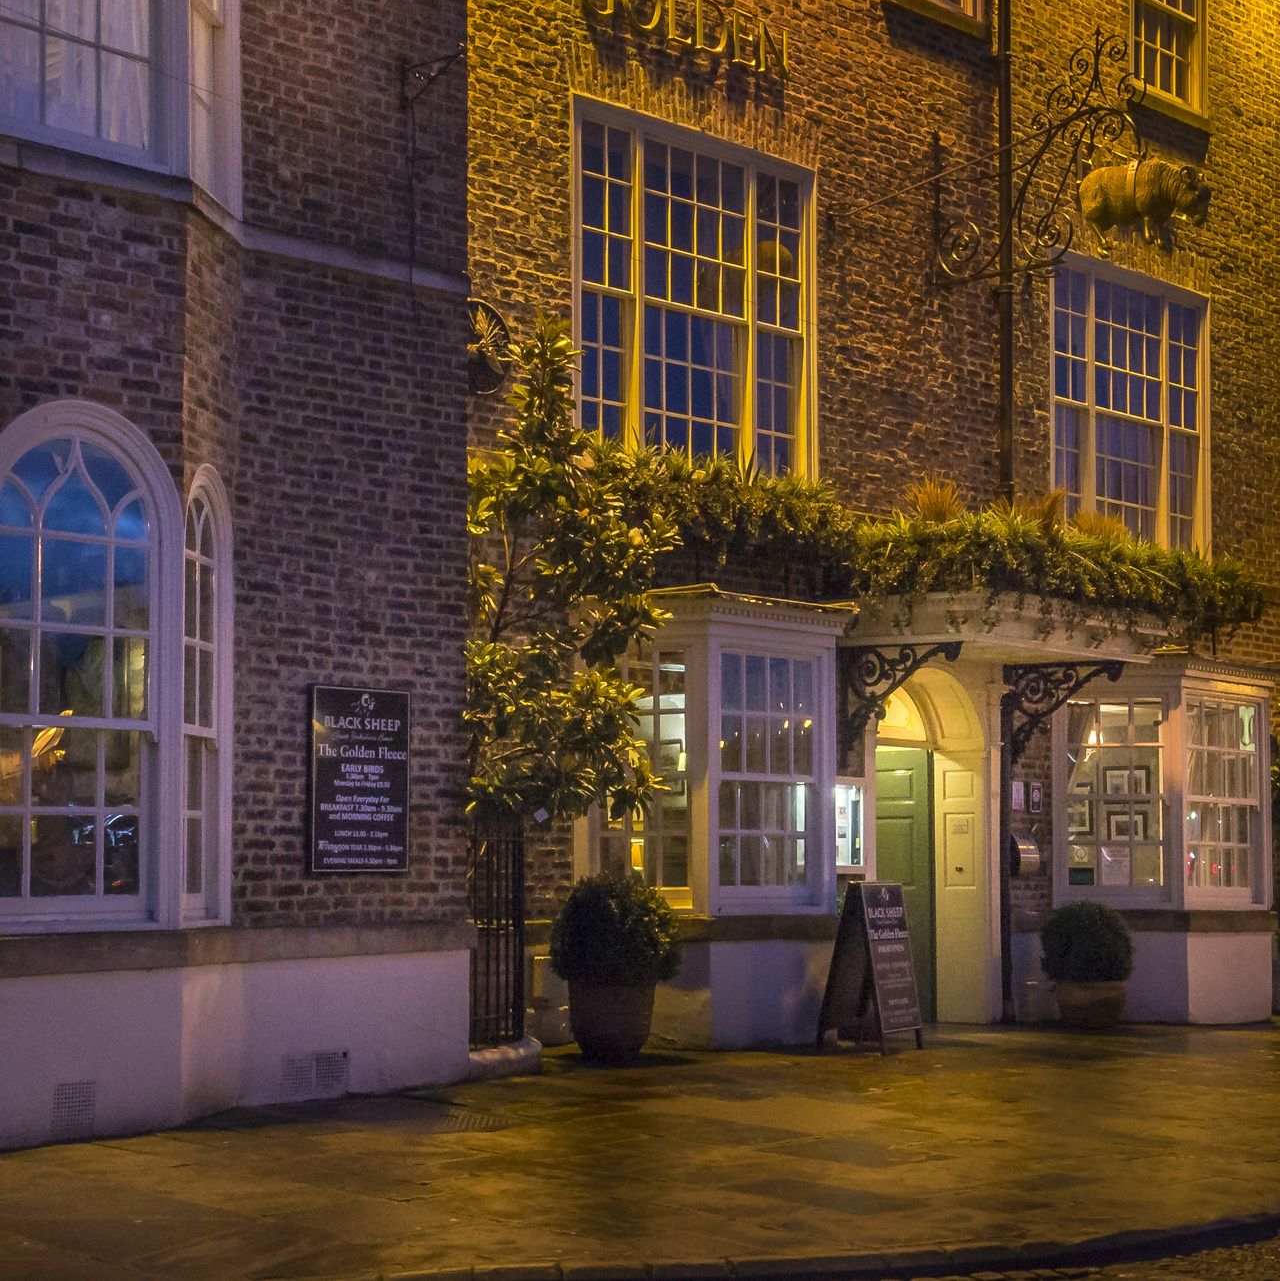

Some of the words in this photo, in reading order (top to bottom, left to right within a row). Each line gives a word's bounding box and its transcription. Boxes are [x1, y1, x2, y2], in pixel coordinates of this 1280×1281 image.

[324, 715, 362, 729] BLACK
[364, 718, 401, 732] SHEEP
[317, 743, 338, 757] The
[340, 744, 376, 758] Golden
[378, 746, 407, 760] Fleece
[341, 763, 362, 773] EARLY
[363, 764, 384, 774] BIRDS
[336, 794, 352, 802] Open
[353, 795, 380, 804] Everyday
[320, 803, 354, 812] BREAKFAST
[355, 804, 377, 812] 7.30am
[342, 812, 372, 821] MORNING
[373, 814, 394, 822] COFFEE
[868, 907, 885, 918] BLACK
[886, 906, 903, 918] SHEEP
[869, 928, 878, 940] The
[878, 928, 894, 939] Golden
